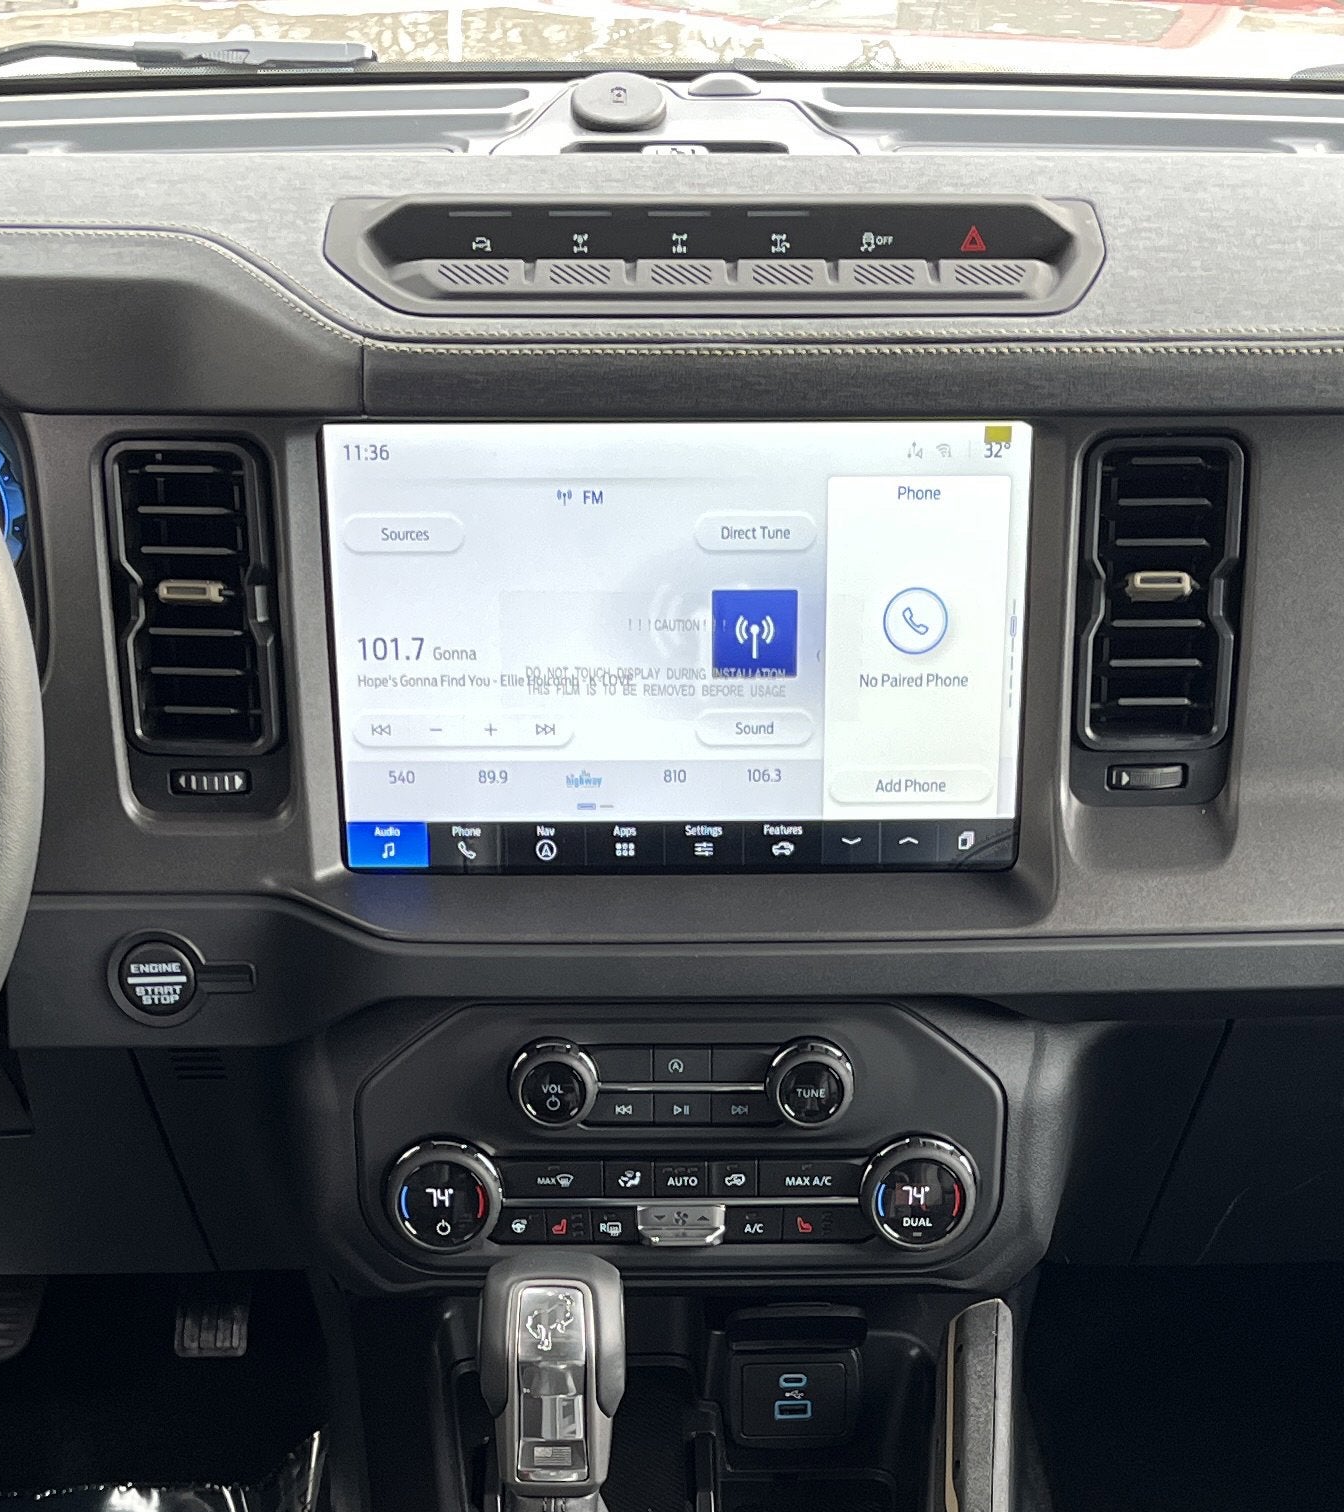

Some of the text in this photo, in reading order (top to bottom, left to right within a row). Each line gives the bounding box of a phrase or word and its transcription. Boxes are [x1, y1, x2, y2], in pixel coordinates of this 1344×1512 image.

[877, 236, 893, 246] OFF
[343, 444, 390, 461] 11:36
[583, 490, 604, 505] FM
[897, 485, 941, 501] Phone
[381, 526, 430, 542] Sources
[721, 525, 791, 541] Direct Tune
[655, 619, 699, 631] CAUTION
[357, 637, 477, 661] 101.7 Gonna
[547, 666, 569, 680] NOT
[574, 666, 611, 680] TOUCH
[617, 666, 660, 680] DISPLAY
[667, 667, 706, 680] DURING
[712, 667, 787, 679] INSTALLATION
[358, 674, 398, 689] Hope's
[400, 674, 438, 688] Gonna
[440, 674, 466, 688] Find
[468, 674, 491, 688] You
[500, 674, 525, 688] Ellie
[859, 674, 968, 688] No Paired Phone
[527, 684, 787, 697] THIS FILM IS TO BE REMOVED BEFORE USAGE
[735, 721, 774, 736] Sound
[388, 770, 416, 785] 540
[478, 770, 508, 785] 89.9
[566, 774, 603, 788] highway
[663, 769, 687, 783] 810
[747, 768, 782, 783] 106.3
[875, 779, 947, 794] Add Phone
[374, 826, 401, 837] Audio
[452, 826, 482, 837] Phone
[536, 826, 555, 837] Nav
[613, 825, 637, 838] Apps
[684, 824, 723, 838] Settings
[763, 824, 803, 837] Features
[130, 962, 181, 974] ENGINE
[135, 985, 183, 996] START
[142, 995, 180, 1005] STOP
[541, 1083, 564, 1095] VOL
[796, 1088, 827, 1099] TUNE
[537, 1175, 556, 1185] MAX
[667, 1176, 698, 1187] AUTO
[785, 1175, 833, 1187] MAX A/C
[902, 1216, 933, 1227] DUAL
[744, 1222, 764, 1235] A/C
